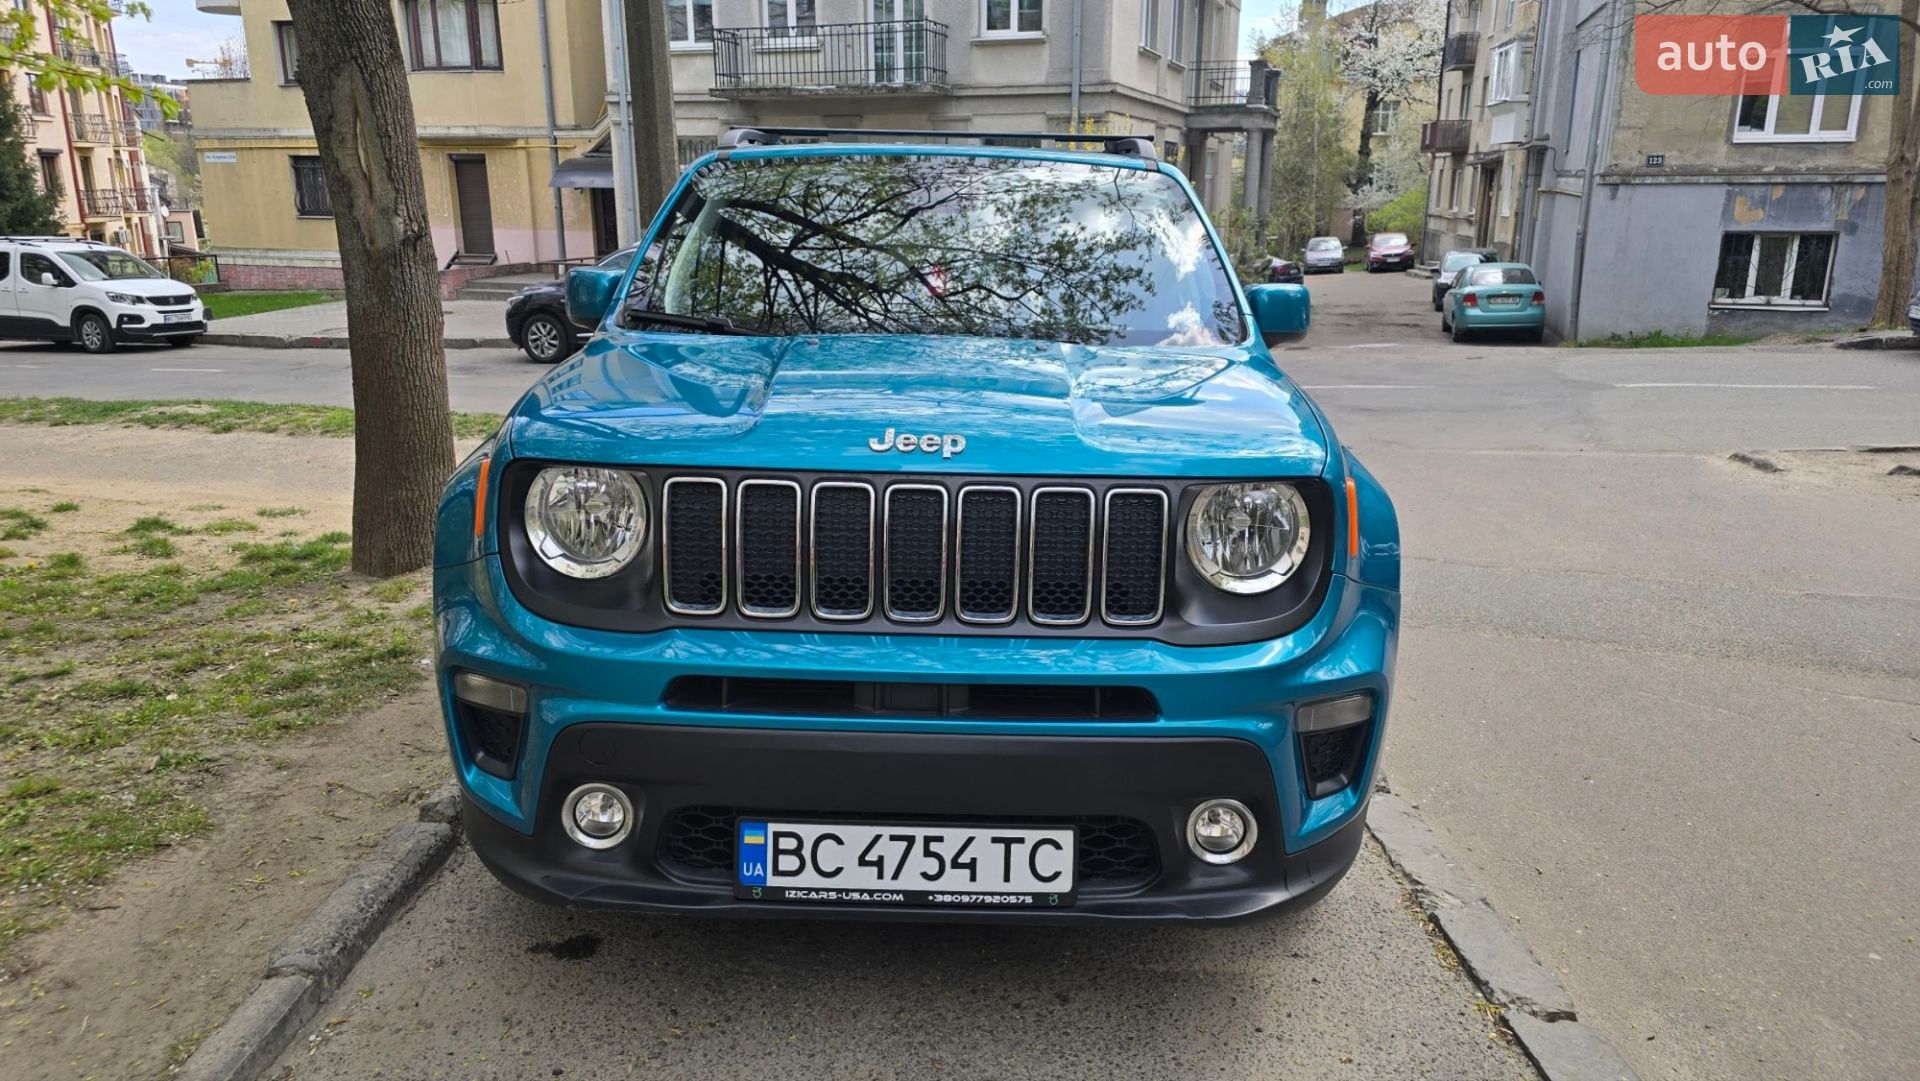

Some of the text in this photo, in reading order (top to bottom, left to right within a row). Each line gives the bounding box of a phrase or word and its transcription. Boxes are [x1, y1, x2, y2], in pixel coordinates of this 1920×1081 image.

[869, 427, 967, 459] Jeep
[772, 830, 1064, 884] BC 4754 TC
[743, 862, 764, 878] UA
[785, 890, 904, 901] IZICARS-USA.COM
